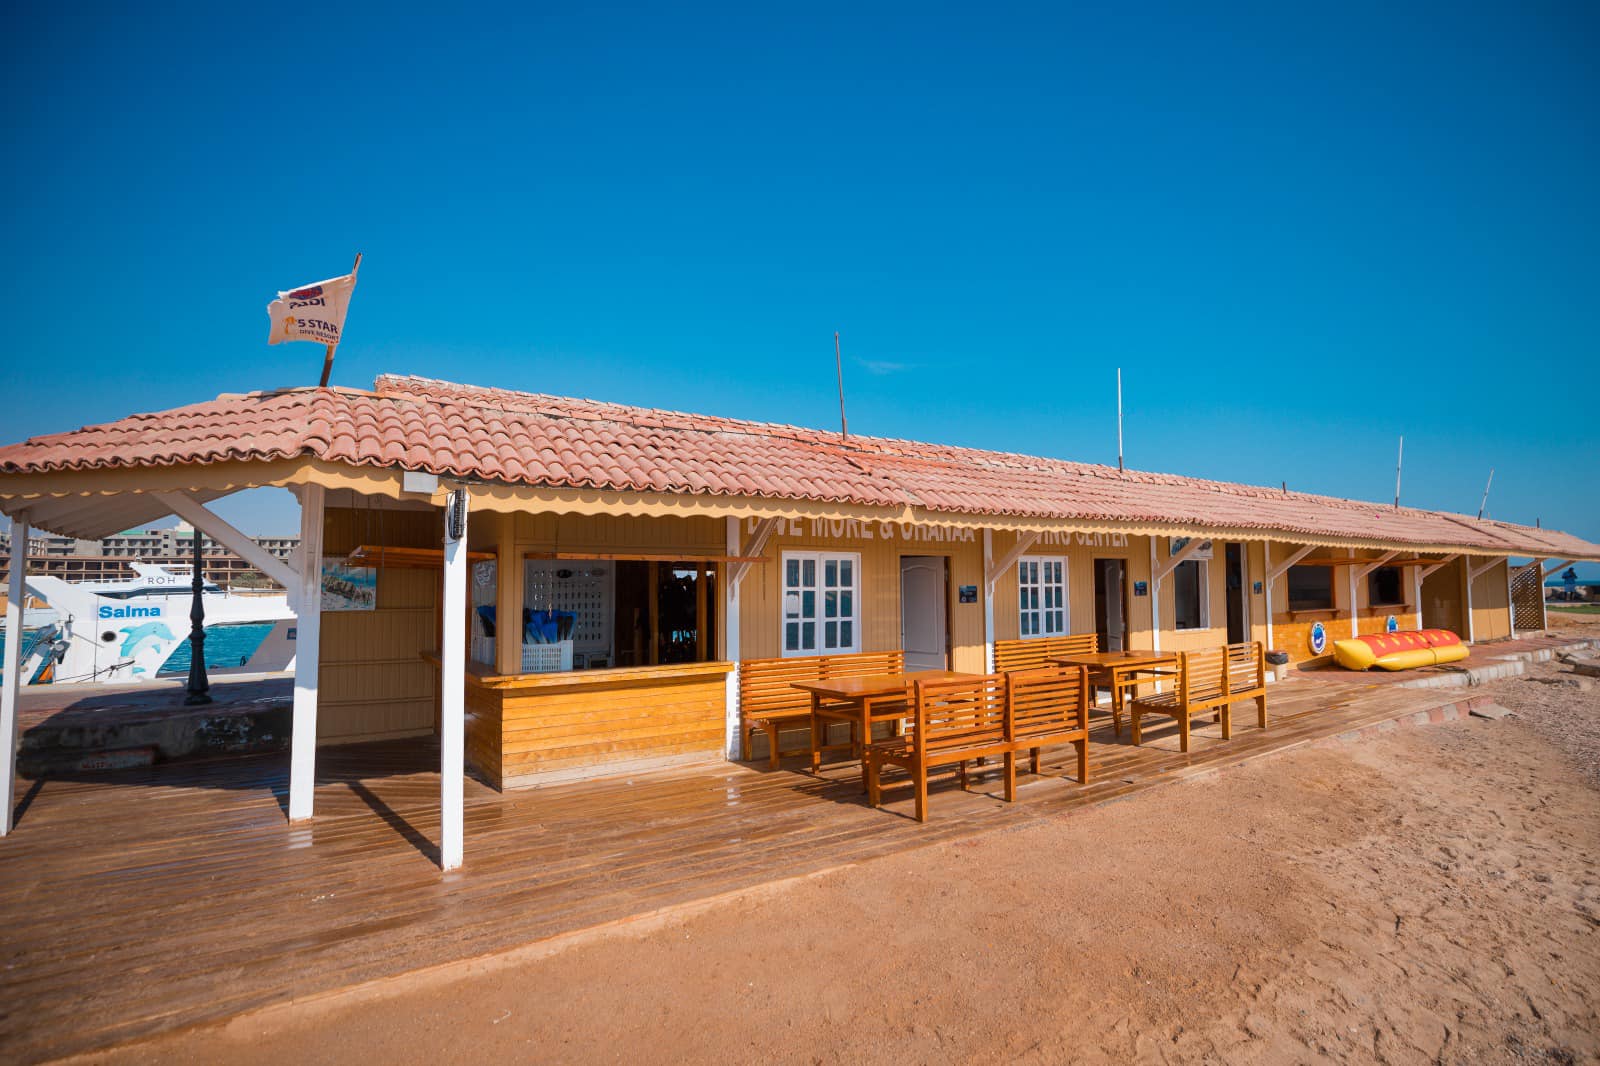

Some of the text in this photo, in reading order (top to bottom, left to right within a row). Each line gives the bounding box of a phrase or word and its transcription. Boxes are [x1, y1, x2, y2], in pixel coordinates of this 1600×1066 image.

[289, 298, 326, 309] PADI
[298, 319, 338, 334] 5 STAR
[147, 576, 177, 585] ROH
[98, 605, 161, 619] Salma
